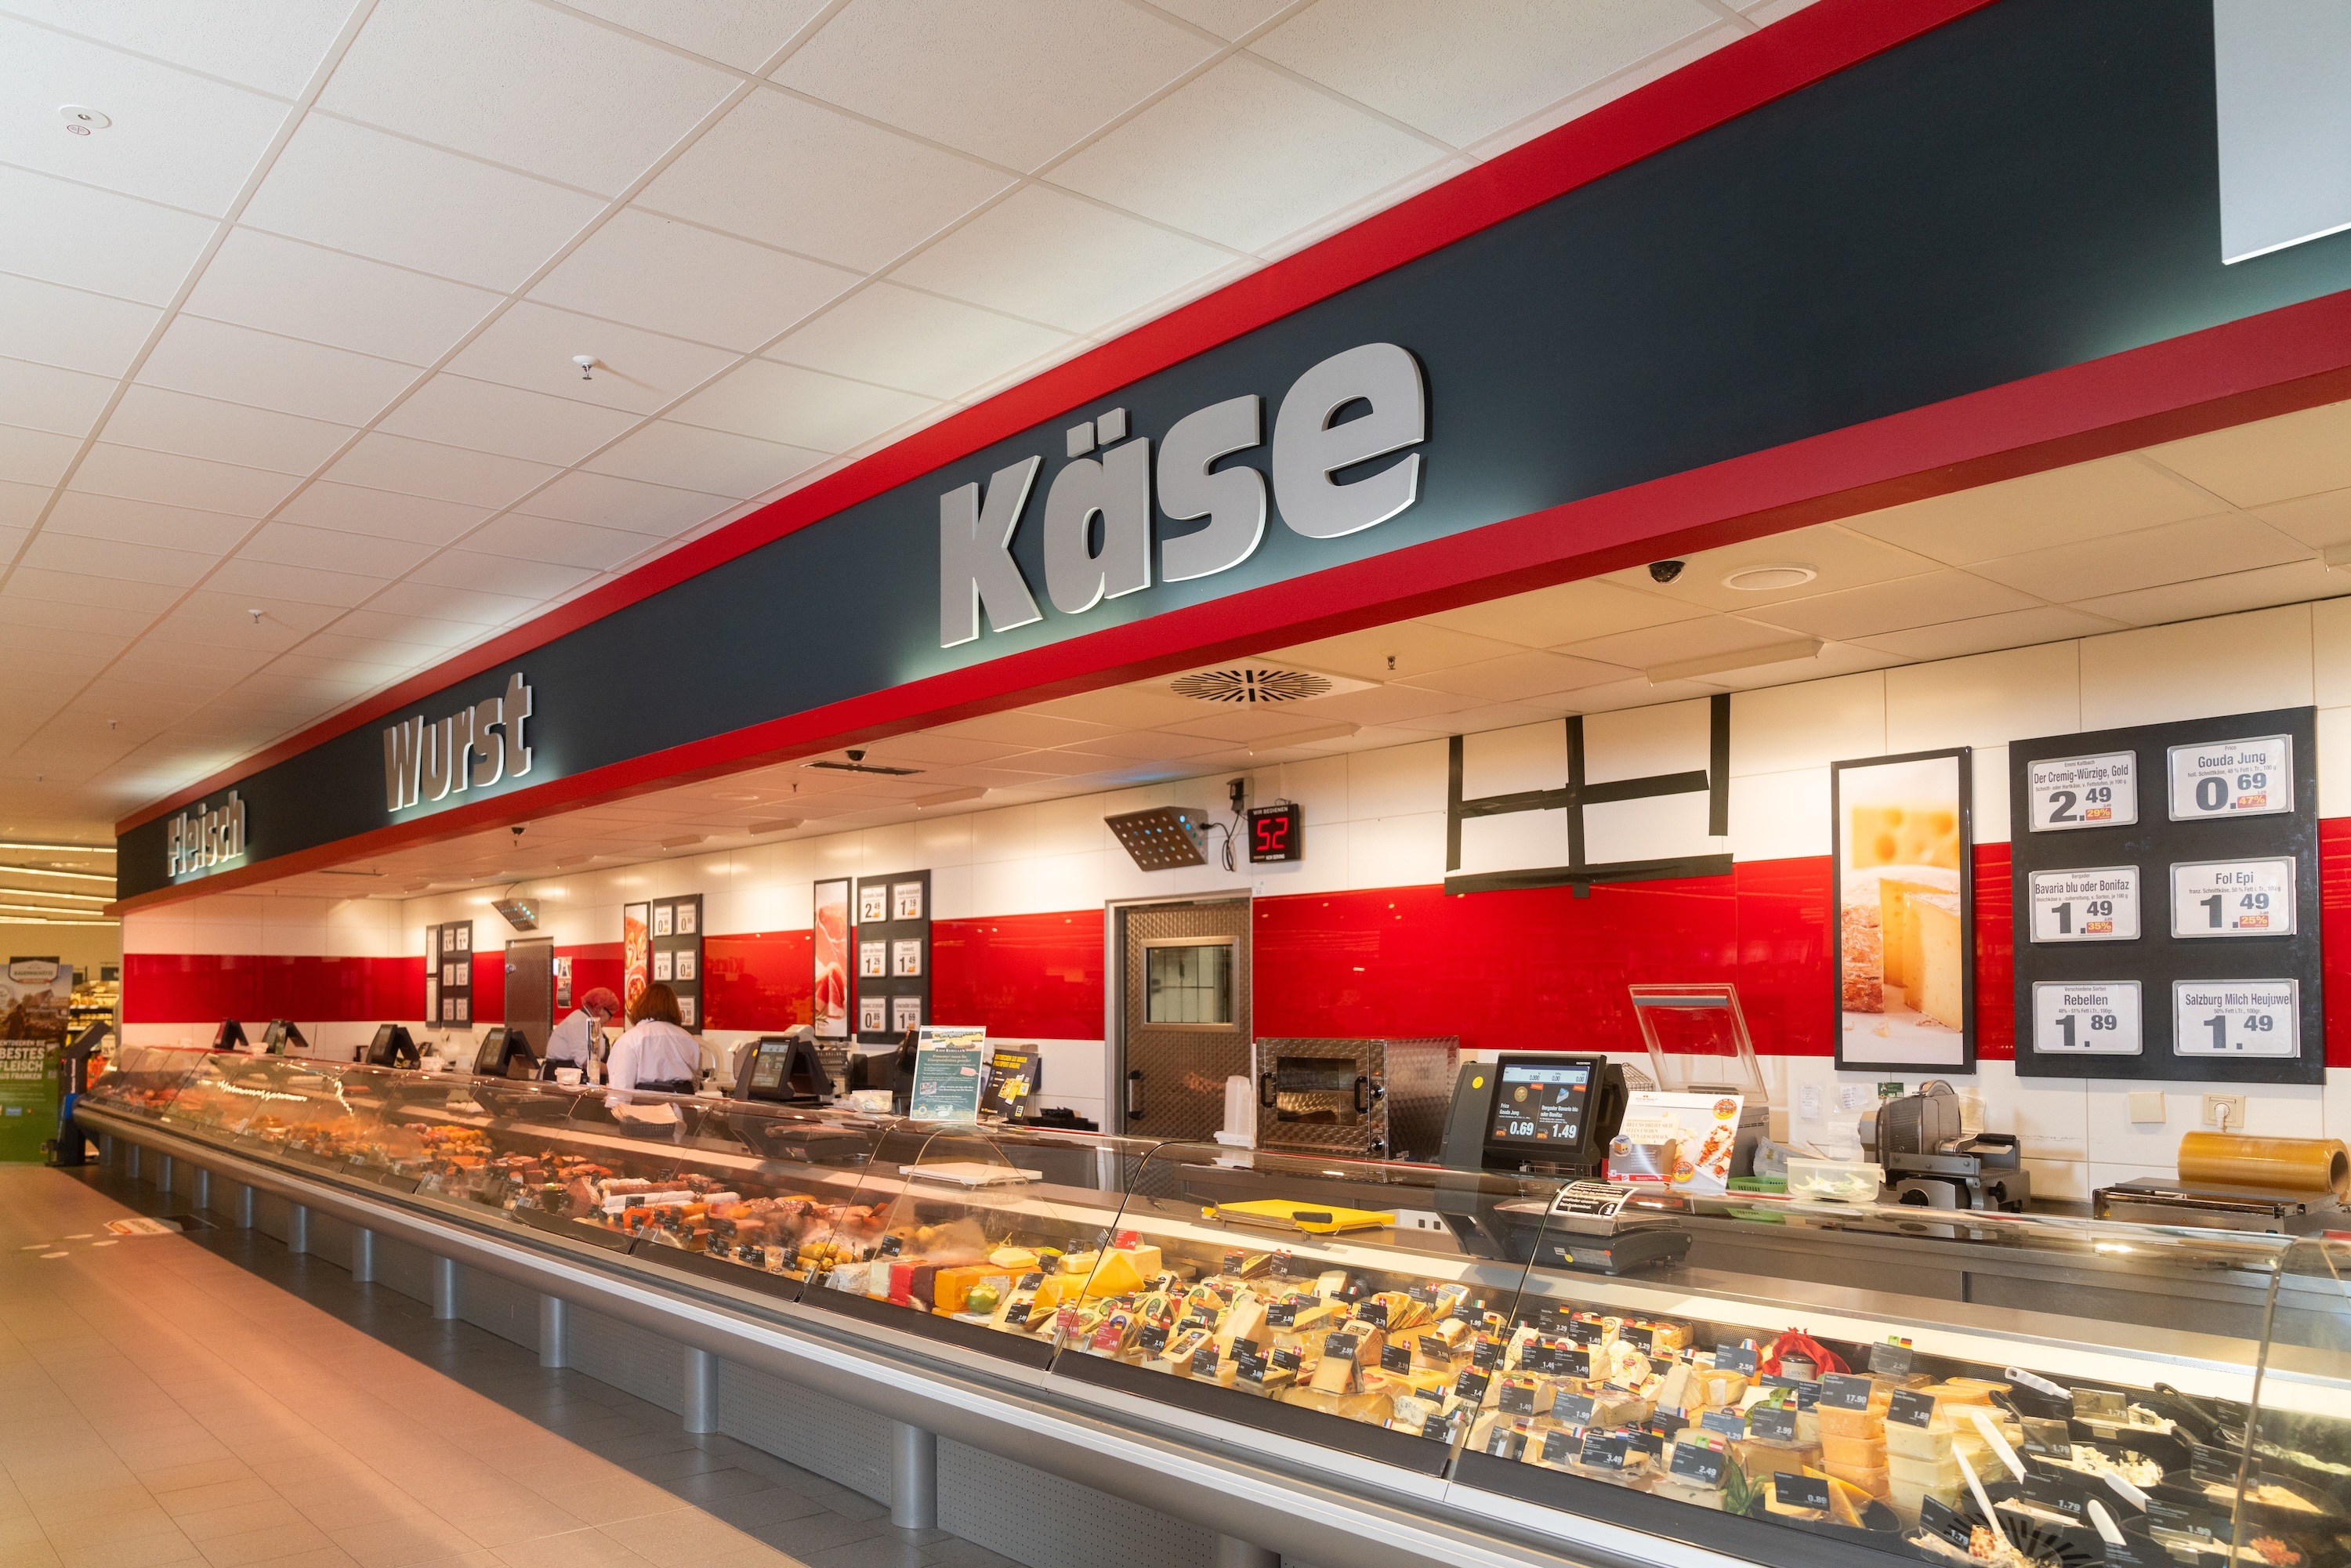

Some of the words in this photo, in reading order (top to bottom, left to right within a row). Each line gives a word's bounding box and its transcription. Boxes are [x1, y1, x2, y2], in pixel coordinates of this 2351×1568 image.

[940, 342, 1425, 648] Käse
[383, 672, 532, 813] Wurst
[2198, 755, 2233, 768] Gouda
[2237, 752, 2266, 765] Jung
[2034, 773, 2046, 784] Der
[2049, 767, 2110, 783] Cremig-Würzige,
[2111, 764, 2128, 776] Gold
[2238, 795, 2266, 805] 47%
[2087, 809, 2110, 817] 29%
[168, 790, 245, 878] Fleisch
[1256, 817, 1288, 851] 52
[2215, 872, 2232, 885] Fol
[2236, 871, 2254, 885] Epi
[2035, 882, 2063, 894] Bavaria
[2066, 882, 2078, 893] blu
[2080, 881, 2097, 892] oder
[2100, 879, 2129, 891] Bonifaz
[2088, 922, 2112, 930] 35%
[2241, 916, 2268, 925] 25%
[2064, 994, 2108, 1005] Rebellen
[2186, 994, 2222, 1007] Salzburg
[2225, 994, 2248, 1005] Milch
[0, 1048, 45, 1059] BESTES
[0, 1060, 43, 1071] FLEISCH
[1510, 1121, 1534, 1135] 0.69
[1552, 1124, 1577, 1139] 1.49
[1846, 1393, 1867, 1403] 17.90
[1576, 1410, 1590, 1419] 1.99
[1914, 1410, 1929, 1421] 1.69
[1726, 1432, 1741, 1440] 3.29
[2052, 1444, 2070, 1454] 1.79
[1607, 1454, 1623, 1464] 3.49
[1699, 1465, 1716, 1476] 2.49
[1807, 1494, 1827, 1504] 0.89
[2058, 1499, 2081, 1512] 1.79
[1950, 1529, 1969, 1544] 1.79
